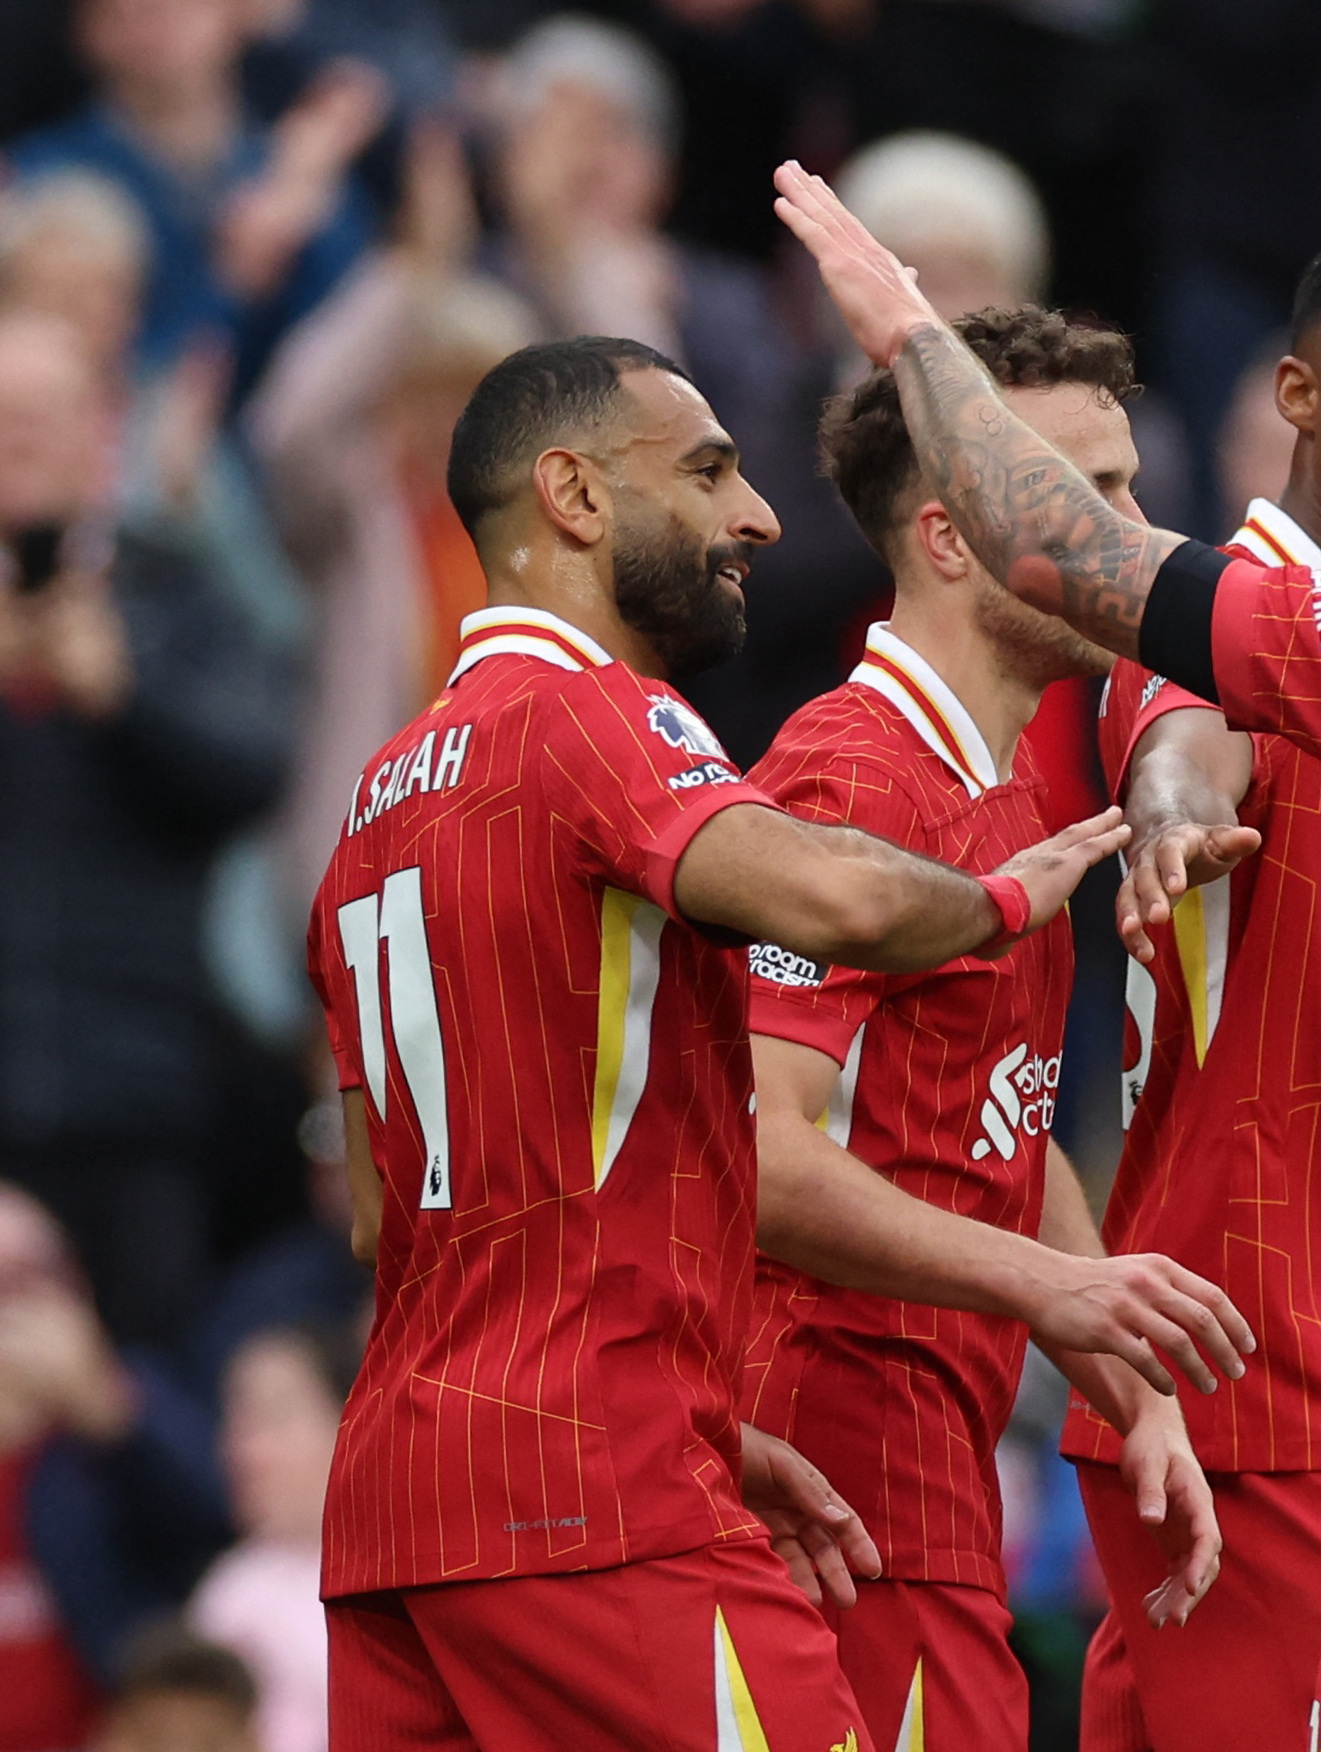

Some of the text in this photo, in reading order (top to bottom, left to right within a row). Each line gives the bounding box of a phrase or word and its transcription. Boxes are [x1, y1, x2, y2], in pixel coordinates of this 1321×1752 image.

[346, 723, 473, 838] .SALAH
[668, 770, 705, 789] No
[758, 944, 817, 979] room
[336, 865, 453, 1210] 11
